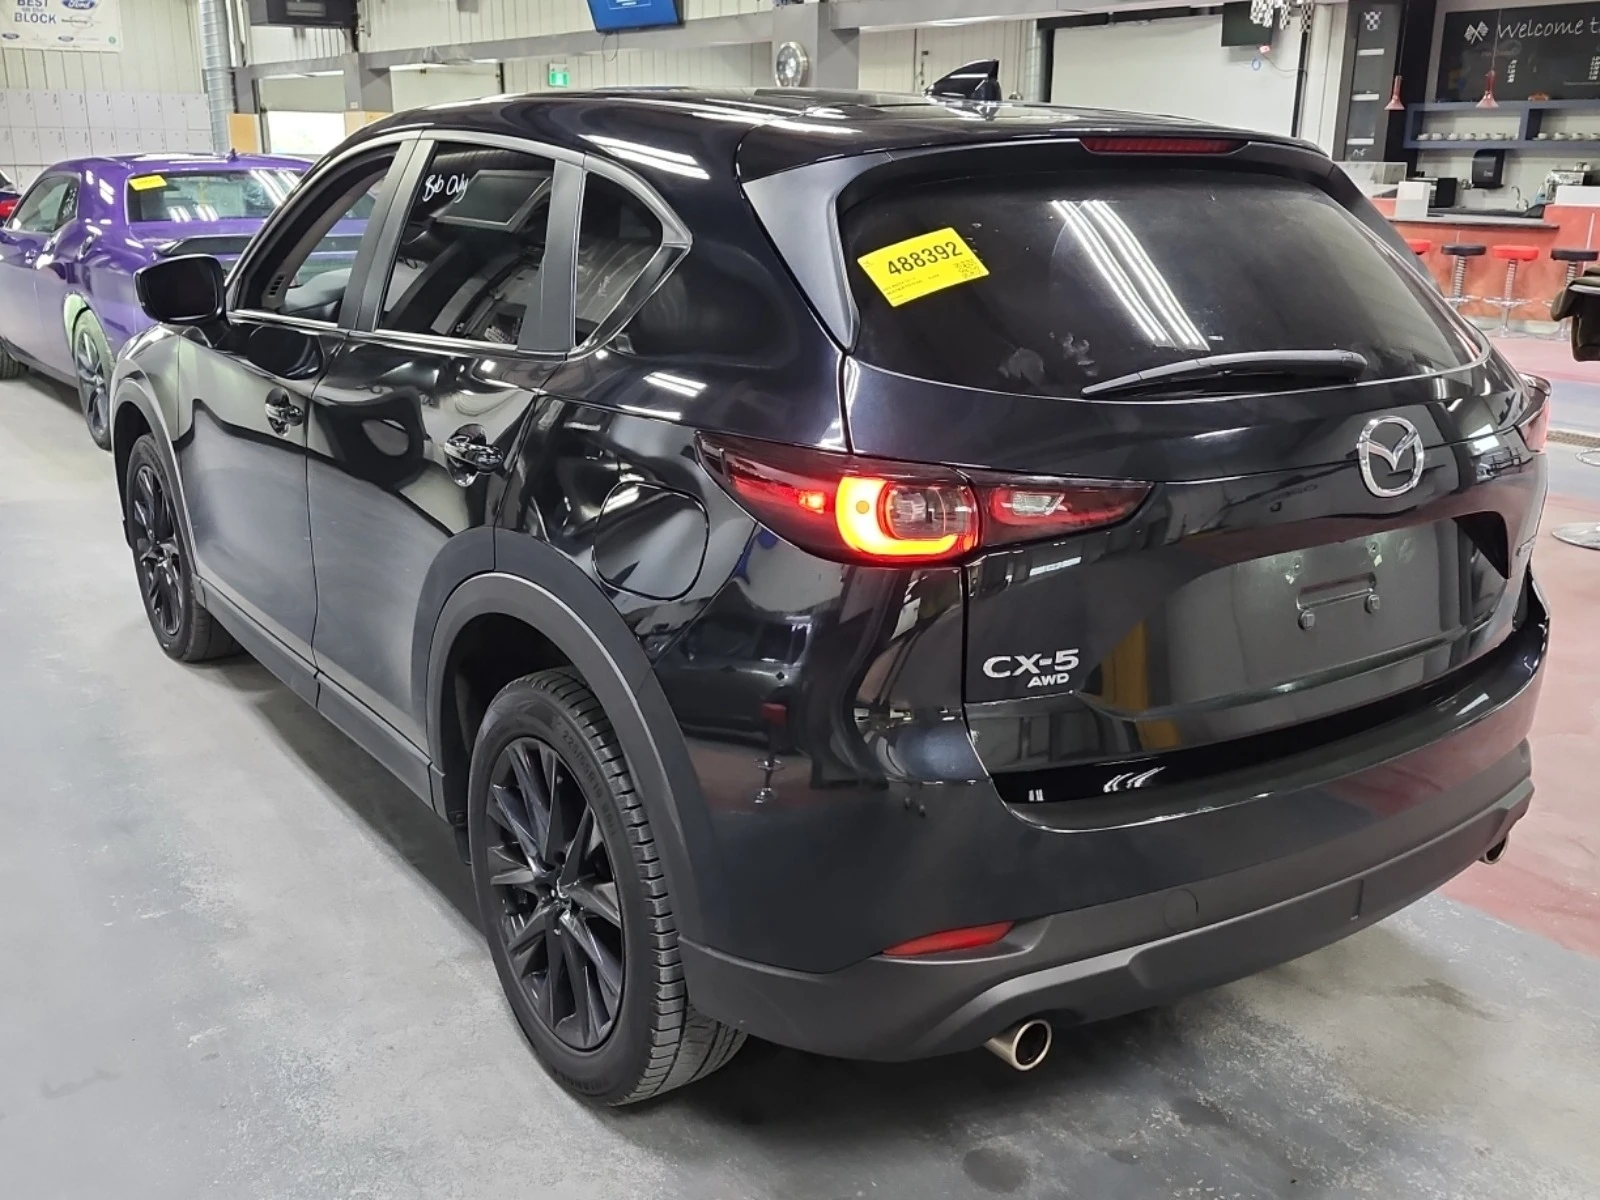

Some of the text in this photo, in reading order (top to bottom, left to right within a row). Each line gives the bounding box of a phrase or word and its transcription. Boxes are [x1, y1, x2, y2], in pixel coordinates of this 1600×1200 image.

[14, 12, 57, 24] BLOCK
[1497, 16, 1600, 39] Welcome t
[888, 241, 963, 276] 488392
[982, 648, 1080, 679] CX-5
[1027, 672, 1070, 689] AWD
